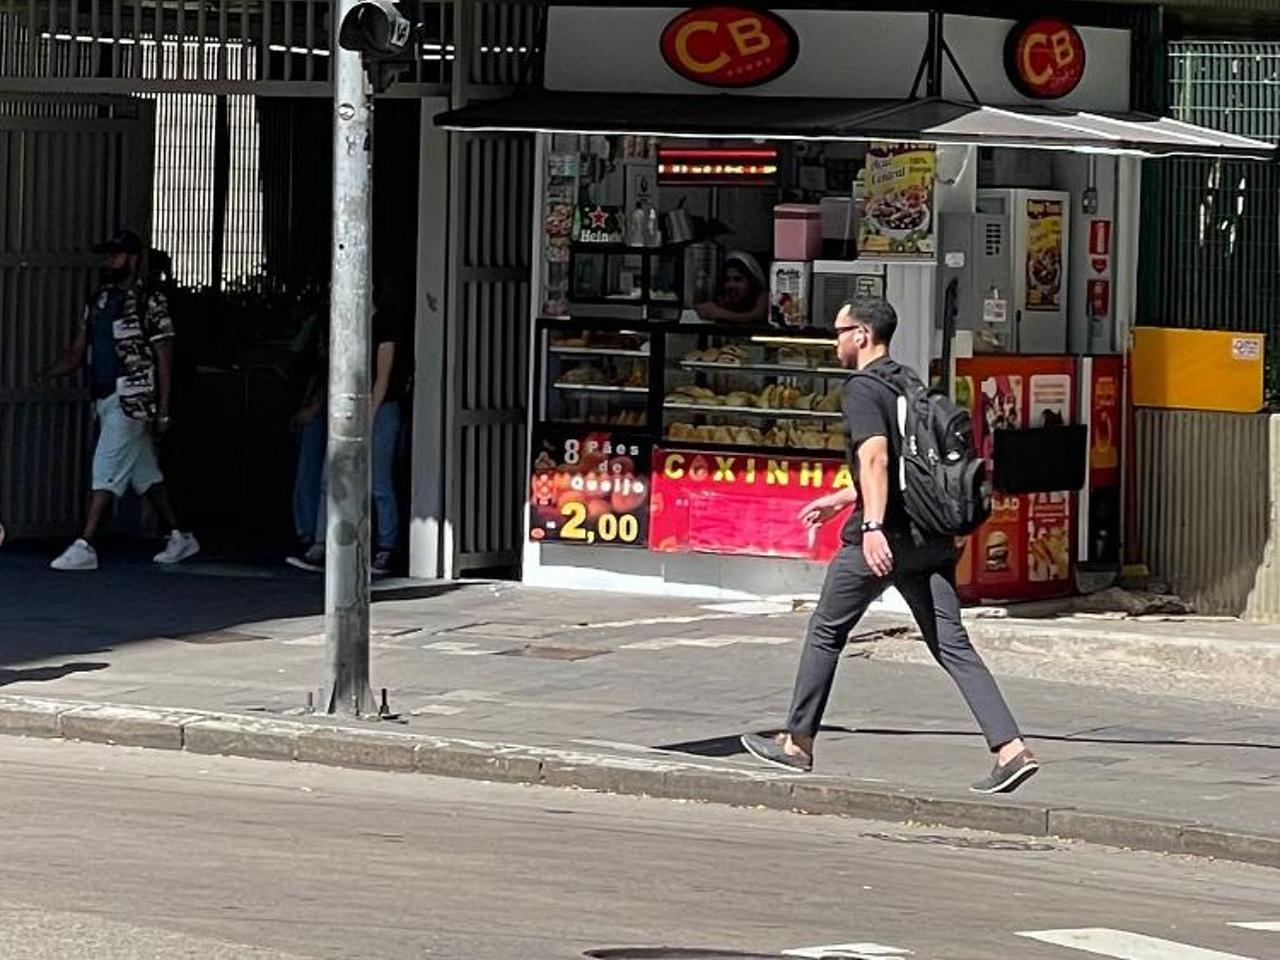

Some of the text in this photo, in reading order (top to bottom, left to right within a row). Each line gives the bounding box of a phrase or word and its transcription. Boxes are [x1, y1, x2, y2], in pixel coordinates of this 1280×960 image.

[675, 17, 771, 74] CB
[1023, 29, 1075, 86] CB
[580, 229, 609, 242] Hein
[564, 439, 580, 464] 8
[560, 502, 639, 544] 2,00
